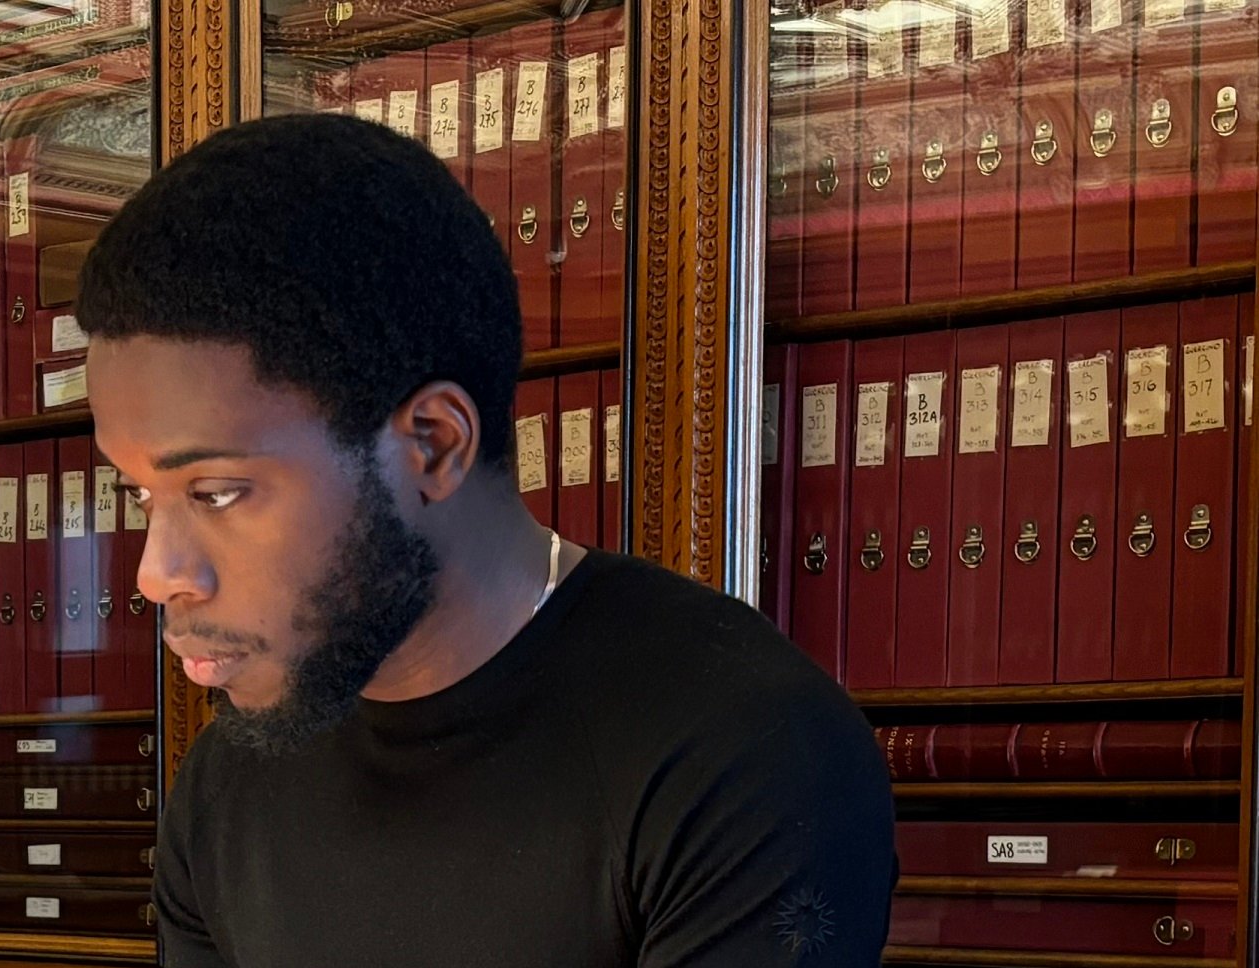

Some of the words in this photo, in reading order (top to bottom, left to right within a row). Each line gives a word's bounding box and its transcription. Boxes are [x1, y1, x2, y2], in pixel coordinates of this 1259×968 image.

[526, 80, 535, 95] B
[578, 76, 587, 94] B
[439, 97, 449, 114] B
[517, 100, 539, 118] 276
[573, 97, 590, 118] 277
[479, 110, 499, 128] 275
[433, 119, 456, 138] 274
[1140, 361, 1152, 377] B
[1197, 354, 1212, 374] B
[1028, 371, 1038, 385] B
[1073, 386, 1099, 405] 315
[1132, 379, 1157, 395] 316
[1188, 378, 1213, 397] 317
[815, 399, 826, 413] B
[868, 396, 879, 410] B
[918, 393, 928, 411] B
[965, 400, 989, 414] 313
[807, 414, 827, 431] 311
[861, 411, 883, 427] 312
[908, 410, 938, 426] 312A
[571, 426, 581, 441] B
[64, 514, 83, 530] 265
[991, 841, 1015, 859] SA8
